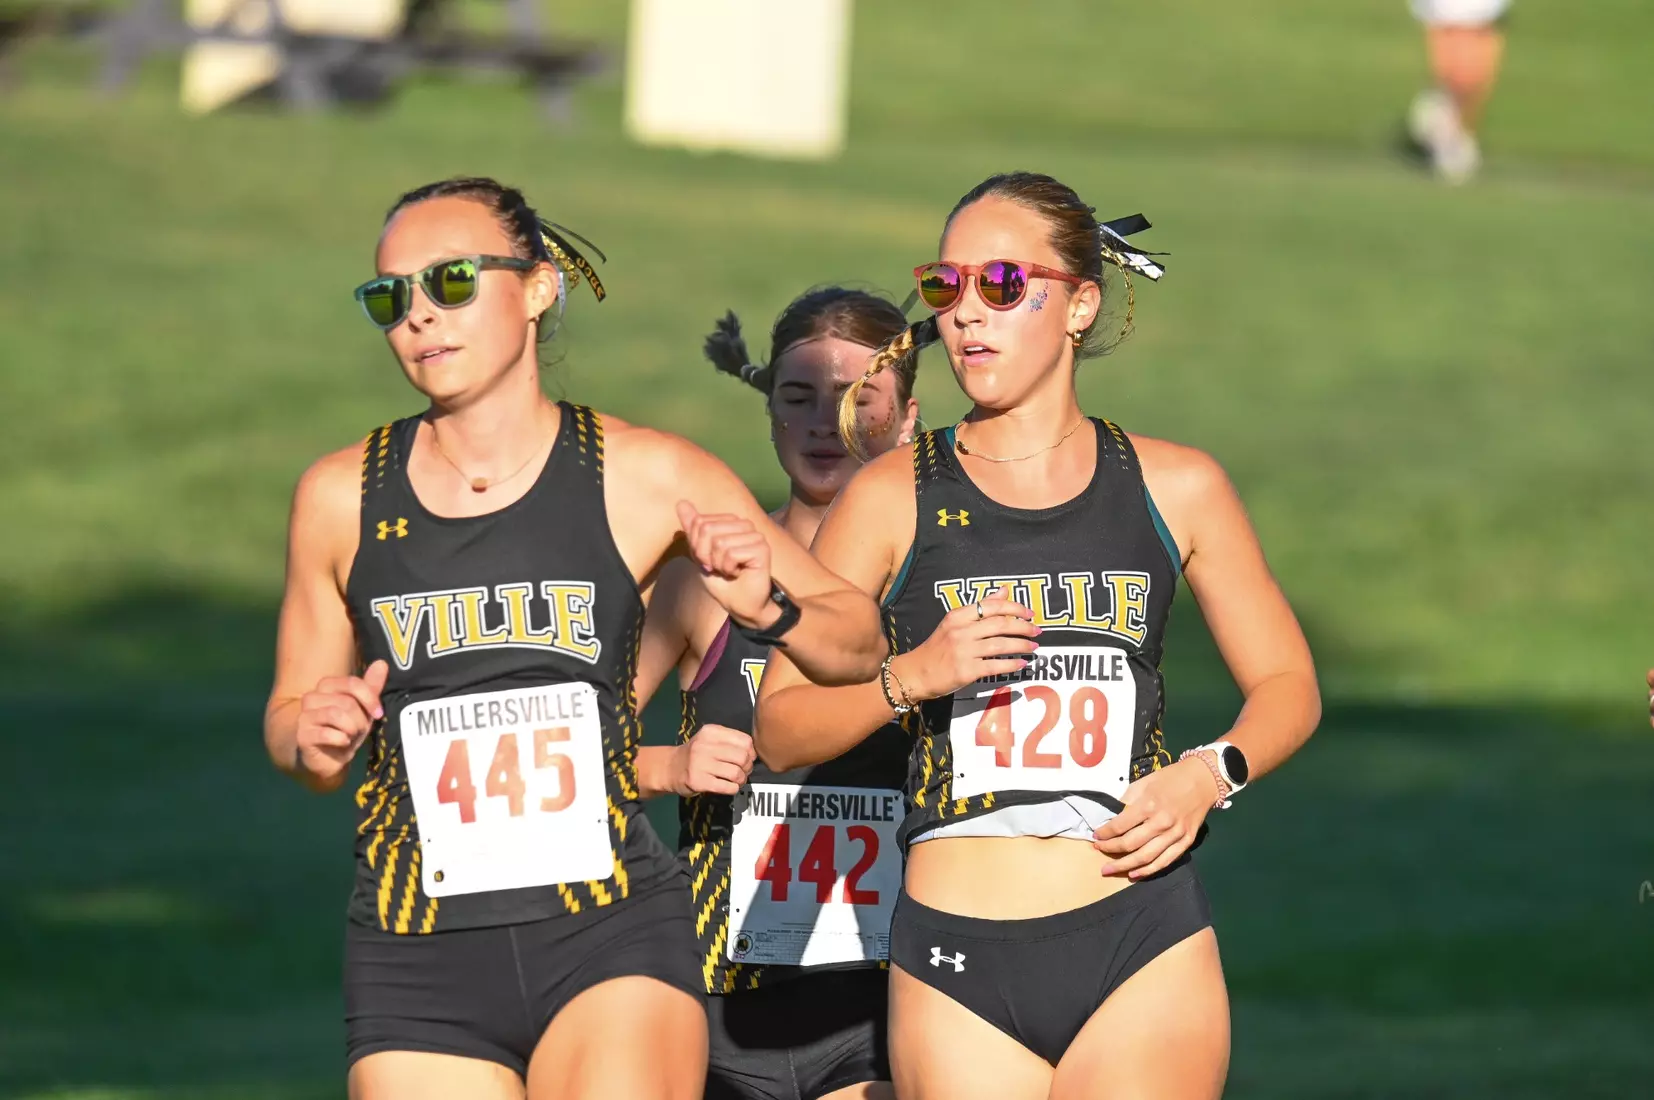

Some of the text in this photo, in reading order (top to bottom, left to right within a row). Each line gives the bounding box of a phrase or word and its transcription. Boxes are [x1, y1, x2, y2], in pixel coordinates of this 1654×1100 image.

[370, 580, 602, 670] VILLE
[976, 654, 1123, 682] ERSVILLE
[417, 691, 584, 736] MILLERSVILLE
[975, 685, 1108, 769] 428
[436, 726, 577, 824] 445
[747, 790, 895, 822] MILLERSVILLE
[754, 823, 880, 906] 442
